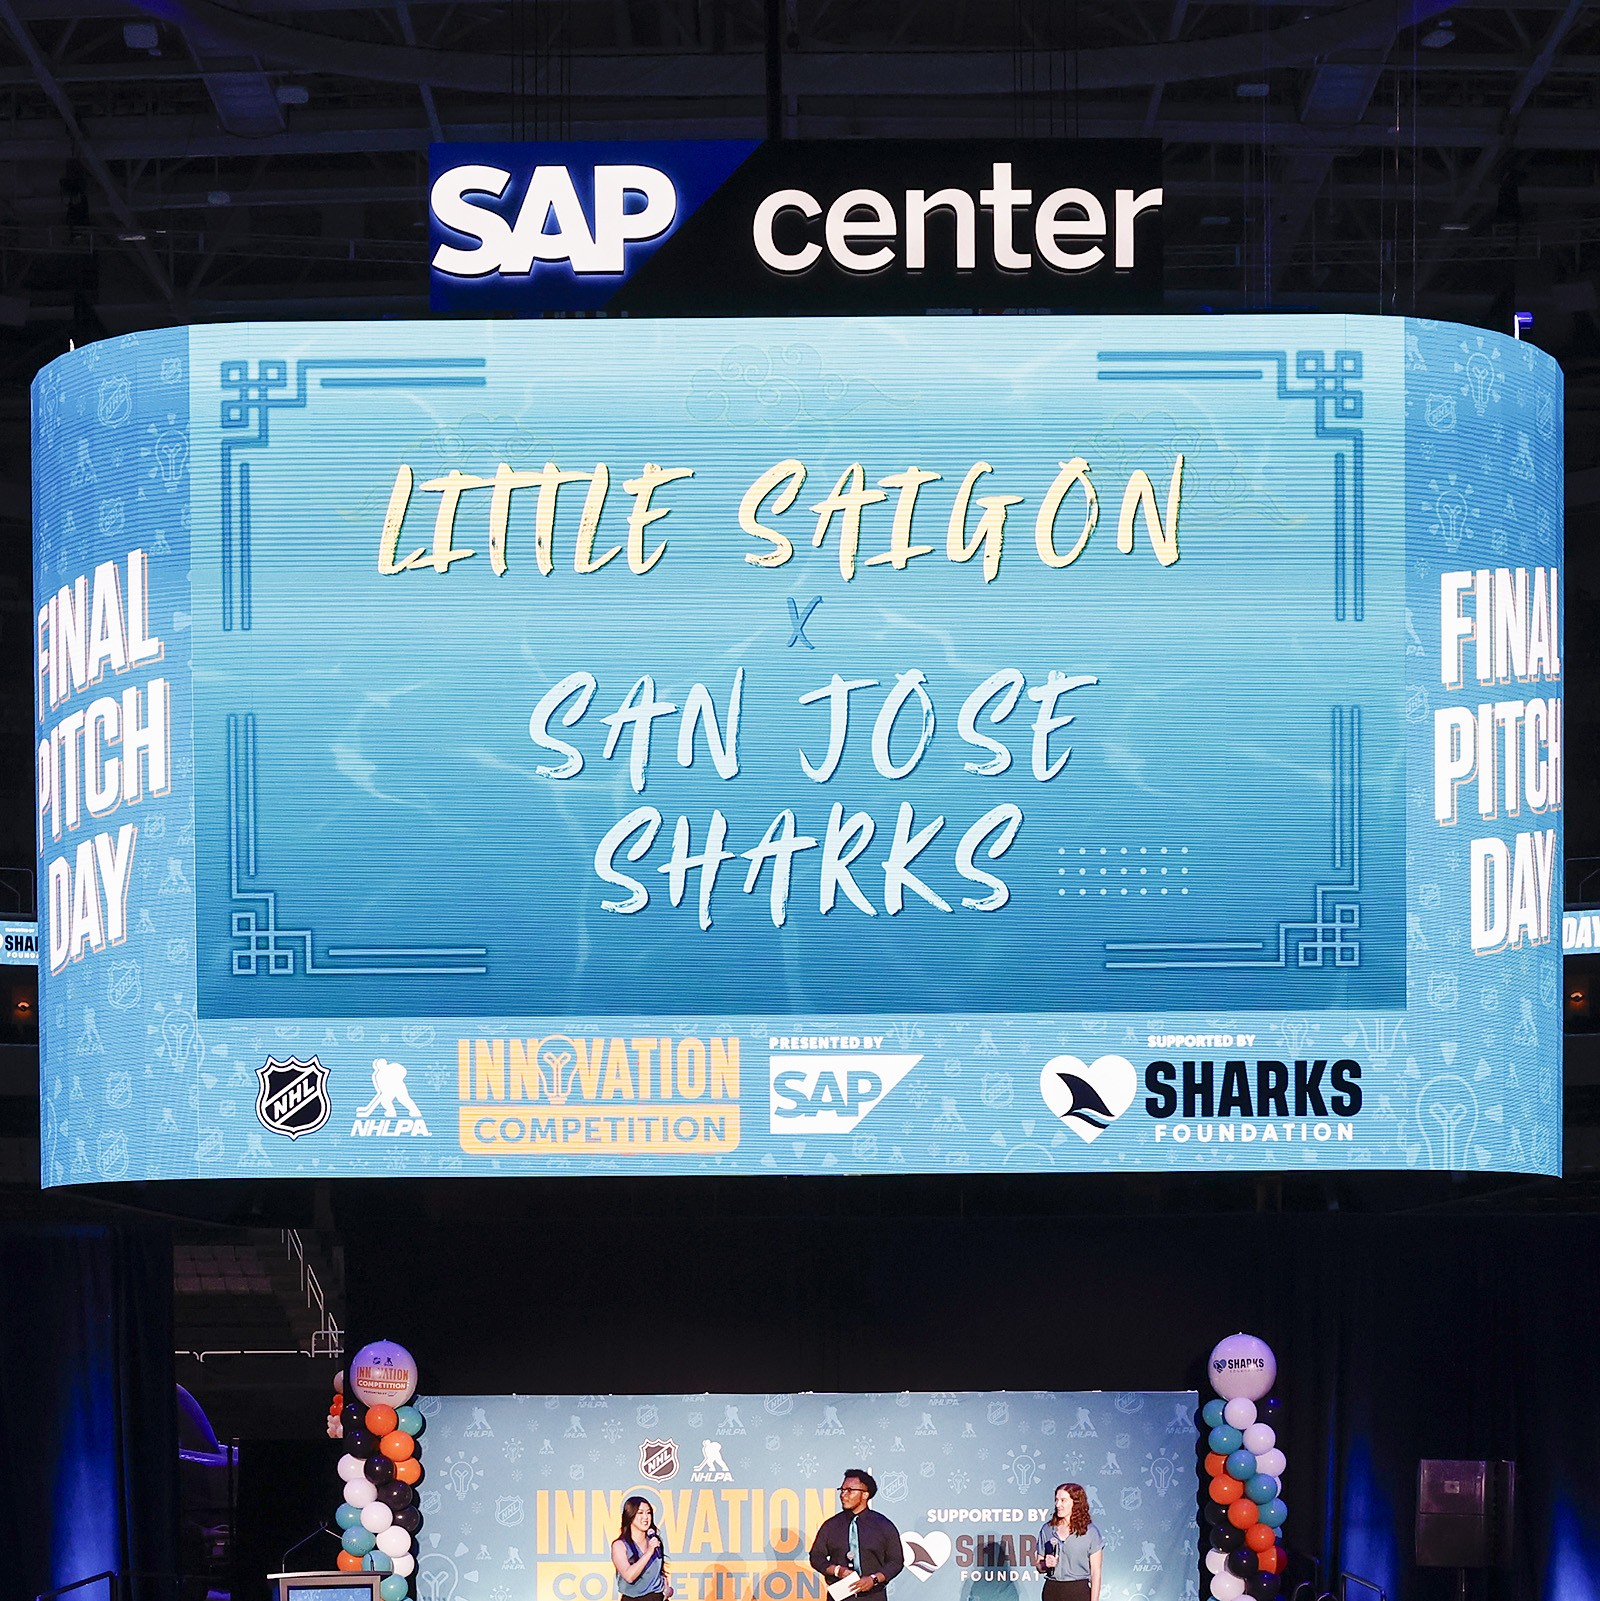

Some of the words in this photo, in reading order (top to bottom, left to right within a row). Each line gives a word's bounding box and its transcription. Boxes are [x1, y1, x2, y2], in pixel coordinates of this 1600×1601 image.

[430, 163, 677, 277] SAP
[753, 161, 1164, 275] center
[377, 456, 694, 577] LITTLE
[737, 452, 1186, 582] SAIGON
[38, 548, 164, 724] FINAL
[1441, 567, 1561, 690] FINAL
[526, 665, 747, 791] SAN
[799, 668, 1100, 783] JOSE
[38, 677, 170, 853] PITCH
[1434, 697, 1562, 826] PITCH
[592, 802, 1026, 930] SHARKS
[49, 823, 138, 976] DAY
[1470, 829, 1556, 956] DAY
[4, 935, 38, 952] SHA
[769, 1036, 857, 1050] PRESENTED
[860, 1036, 884, 1050] BY
[1147, 1034, 1230, 1049] SUPPORTED
[1233, 1034, 1256, 1048] BY
[272, 1071, 317, 1121] NHL
[772, 1069, 883, 1118] SAP
[1144, 1059, 1363, 1118] SHARKS
[350, 1118, 432, 1138] NHLPA
[474, 1114, 726, 1145] COMPETITION
[1155, 1122, 1354, 1144] FOUNDATION
[1227, 1358, 1265, 1369] SHARKS
[358, 1380, 406, 1390] COMPETITION
[716, 1428, 747, 1436] NHLPA
[815, 1428, 846, 1436] NHLPA
[647, 1447, 673, 1472] NHL
[690, 1472, 735, 1483] NHLPA
[537, 1485, 837, 1555] INNVATION
[927, 1508, 1024, 1523] SUPPORTED
[1027, 1508, 1050, 1522] BY
[955, 1534, 1038, 1568] SHAR
[960, 1570, 1041, 1582] FOUNDAT
[1132, 1564, 1164, 1572] NHLPA
[552, 1571, 820, 1601] COETITION
